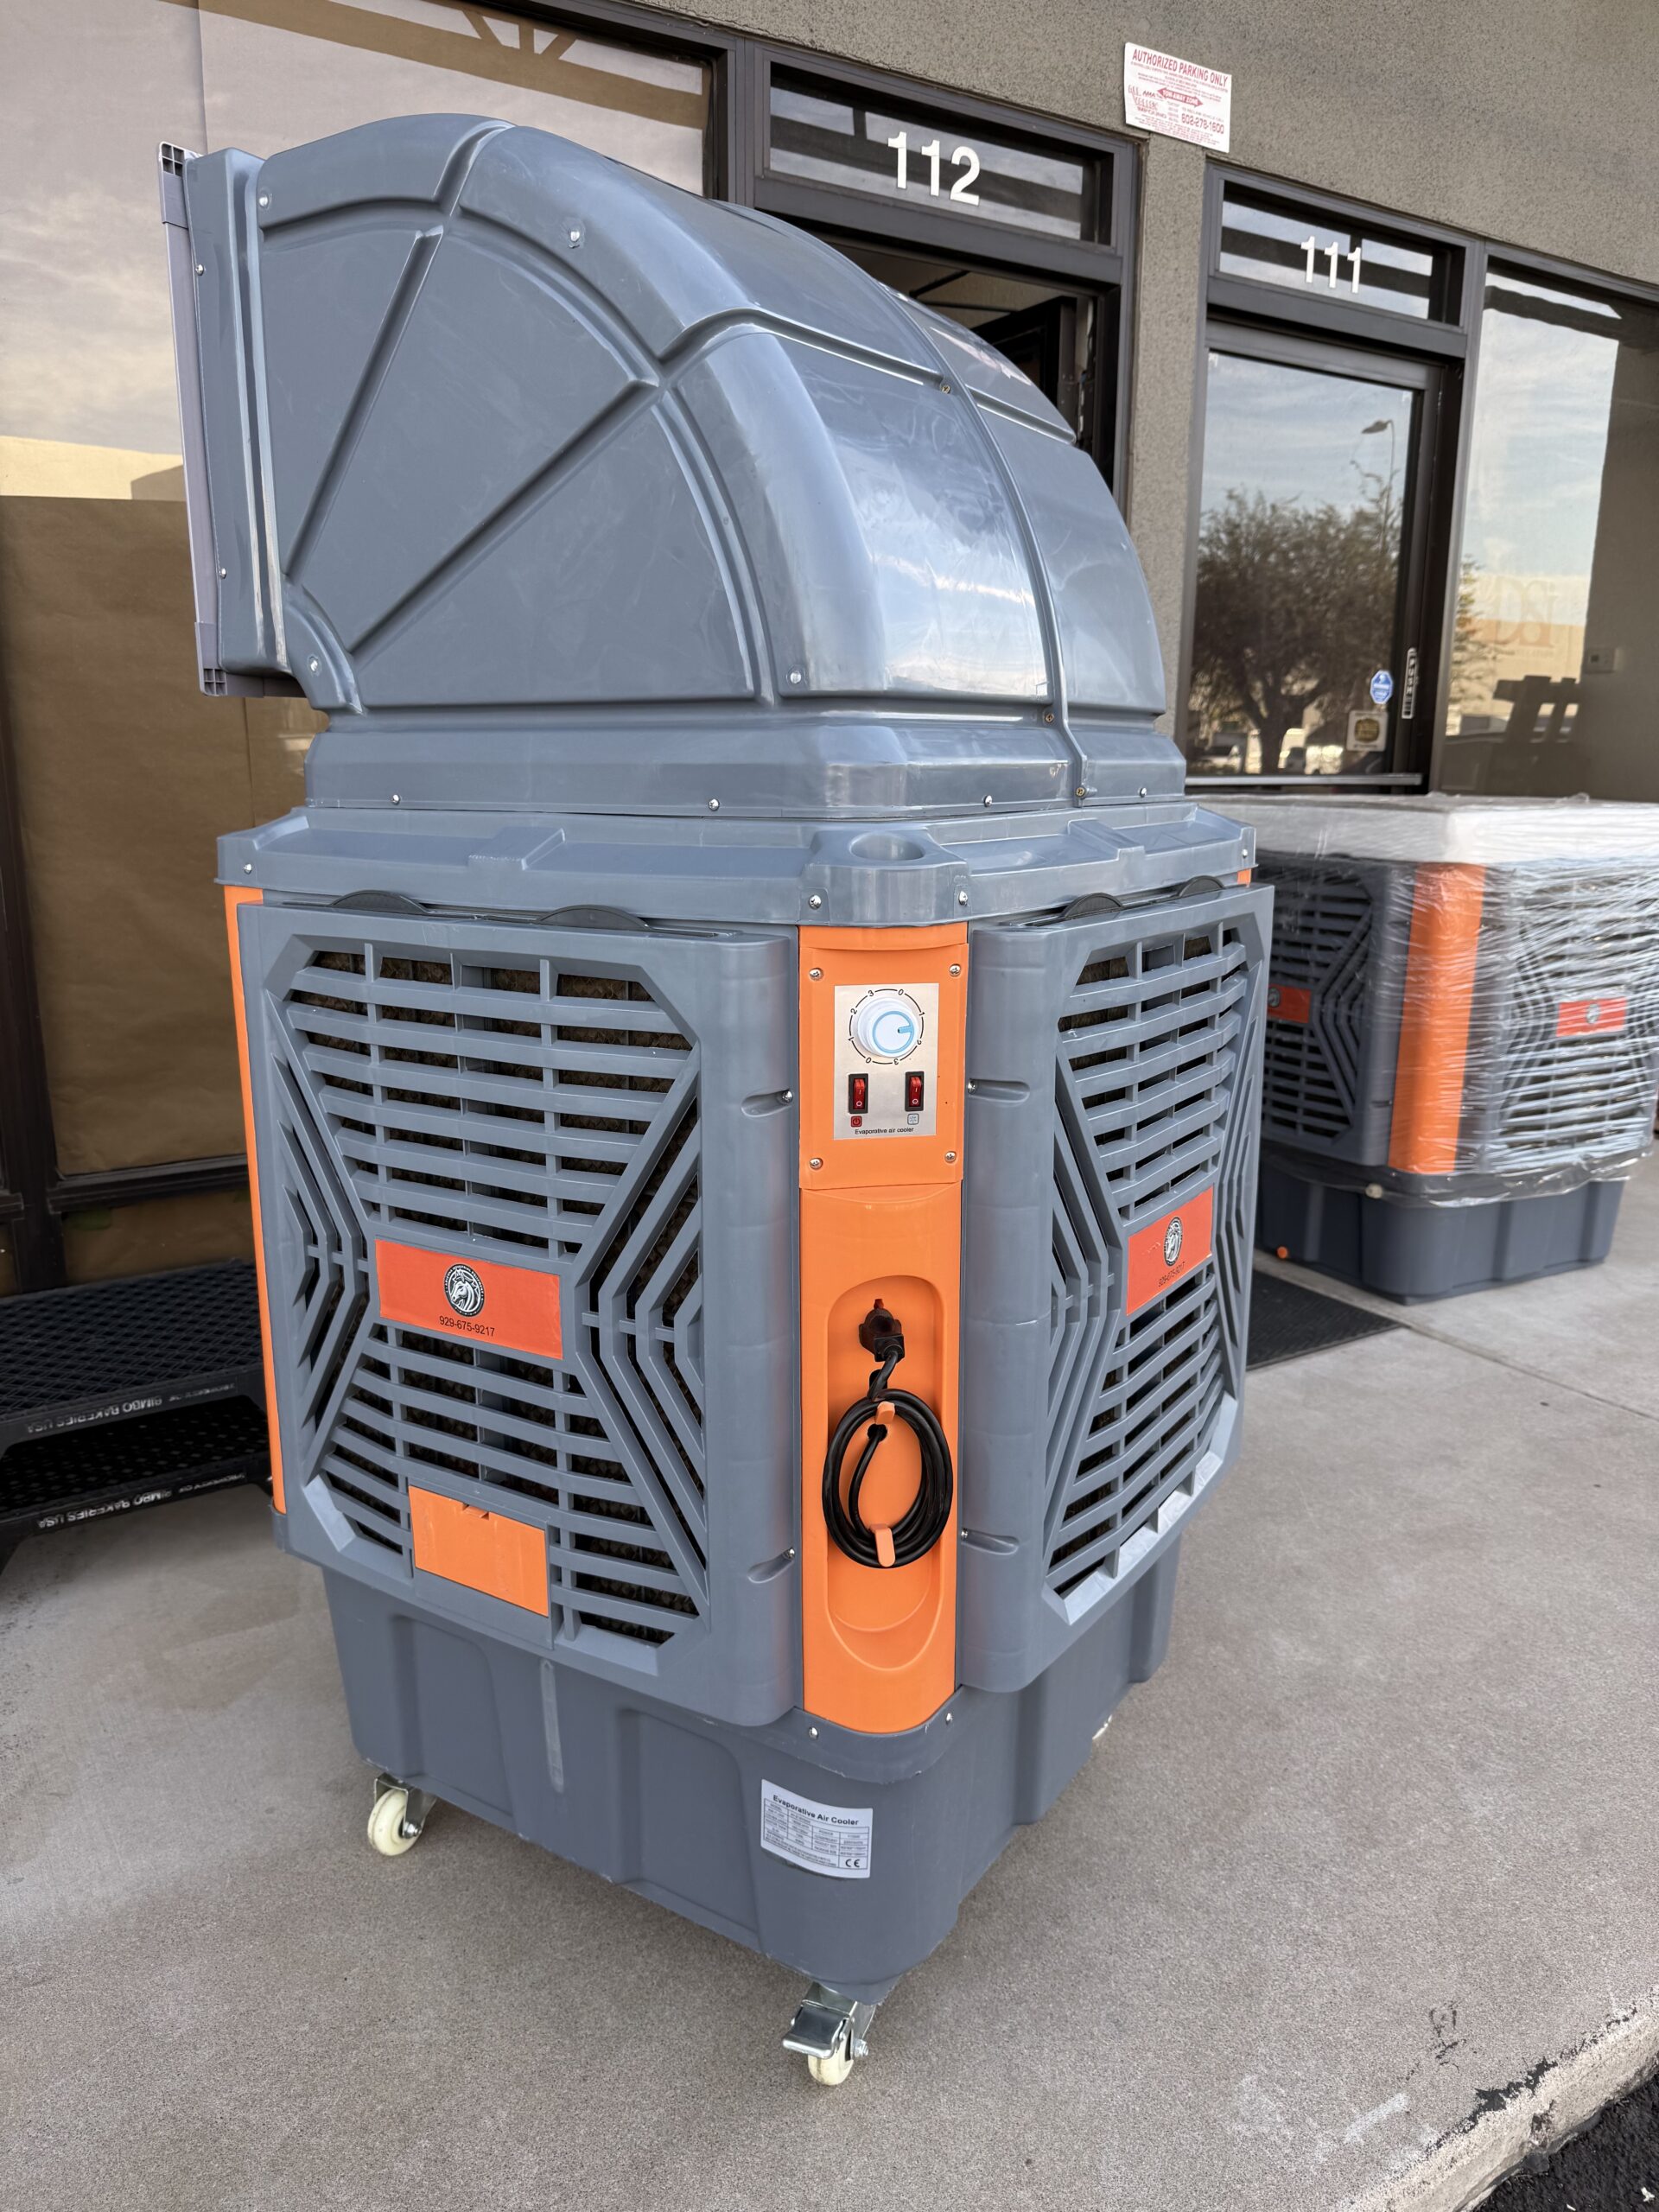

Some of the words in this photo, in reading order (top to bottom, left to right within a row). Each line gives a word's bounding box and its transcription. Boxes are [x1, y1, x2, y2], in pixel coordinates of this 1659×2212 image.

[1132, 48, 1178, 72] AUTHORIZED
[1179, 61, 1209, 82] PARKING
[1210, 72, 1229, 87] ONLY
[887, 131, 981, 207] 112
[1300, 235, 1362, 294] 111
[439, 1316, 494, 1337] 929-675-9217
[772, 1794, 816, 1818] Evaporative
[817, 1812, 830, 1822] Air
[830, 1816, 859, 1826] Cooler
